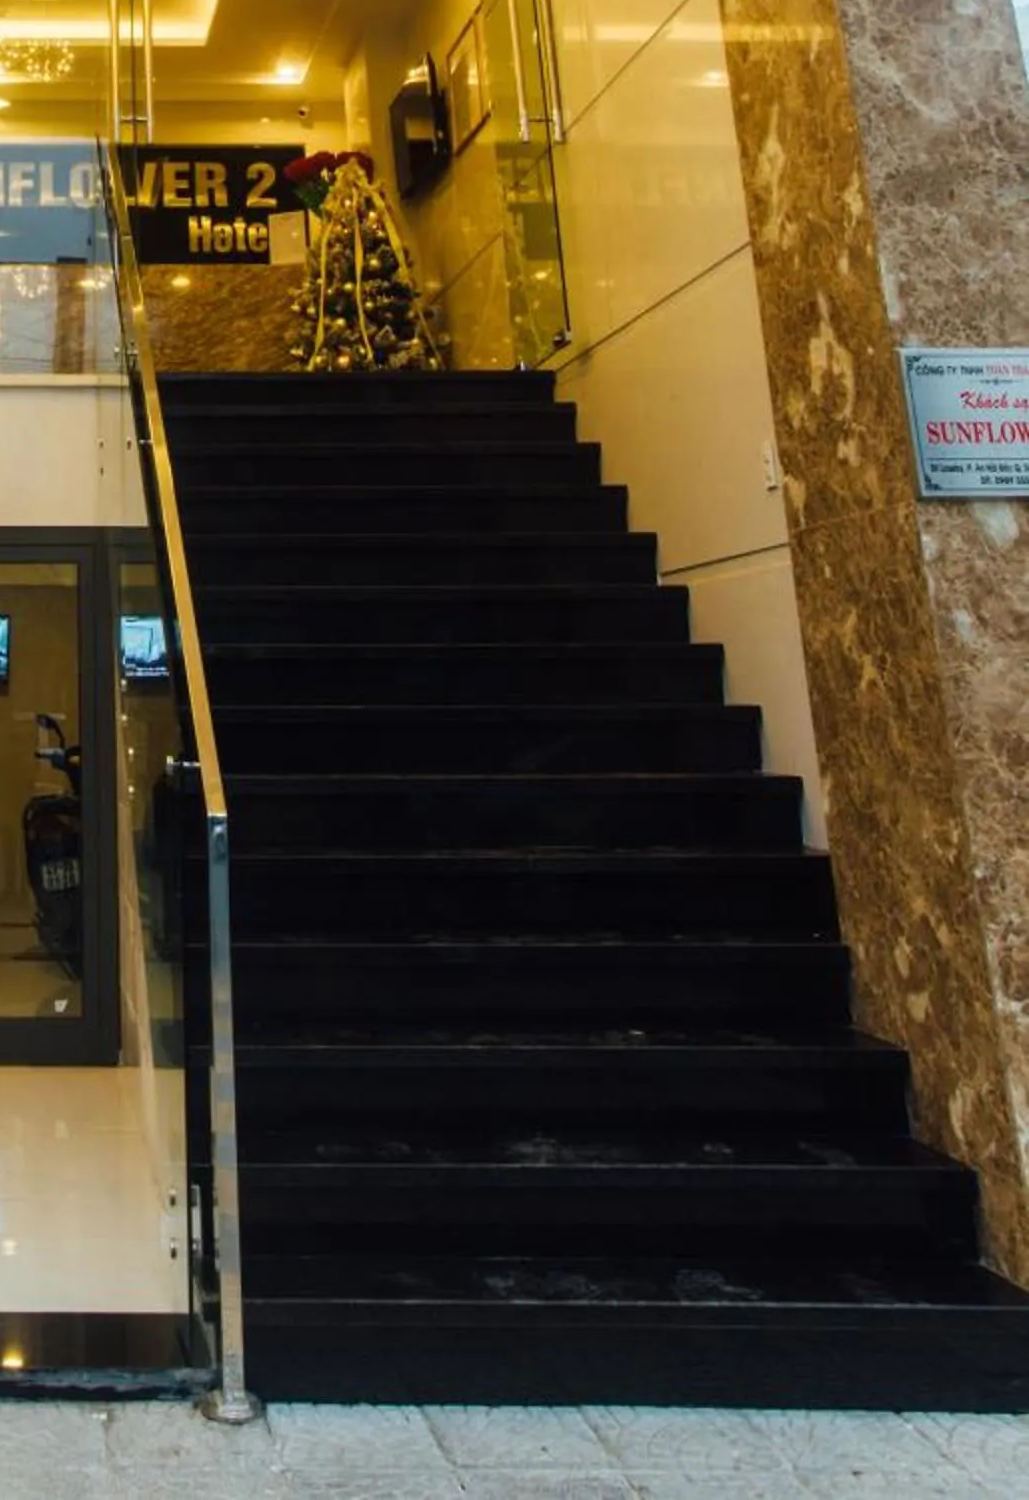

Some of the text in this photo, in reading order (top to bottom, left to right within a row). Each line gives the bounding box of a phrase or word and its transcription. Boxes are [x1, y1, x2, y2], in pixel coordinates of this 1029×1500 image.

[245, 161, 278, 208] 2
[188, 215, 269, 253] Hote
[926, 420, 1029, 445] SUNFLOW
